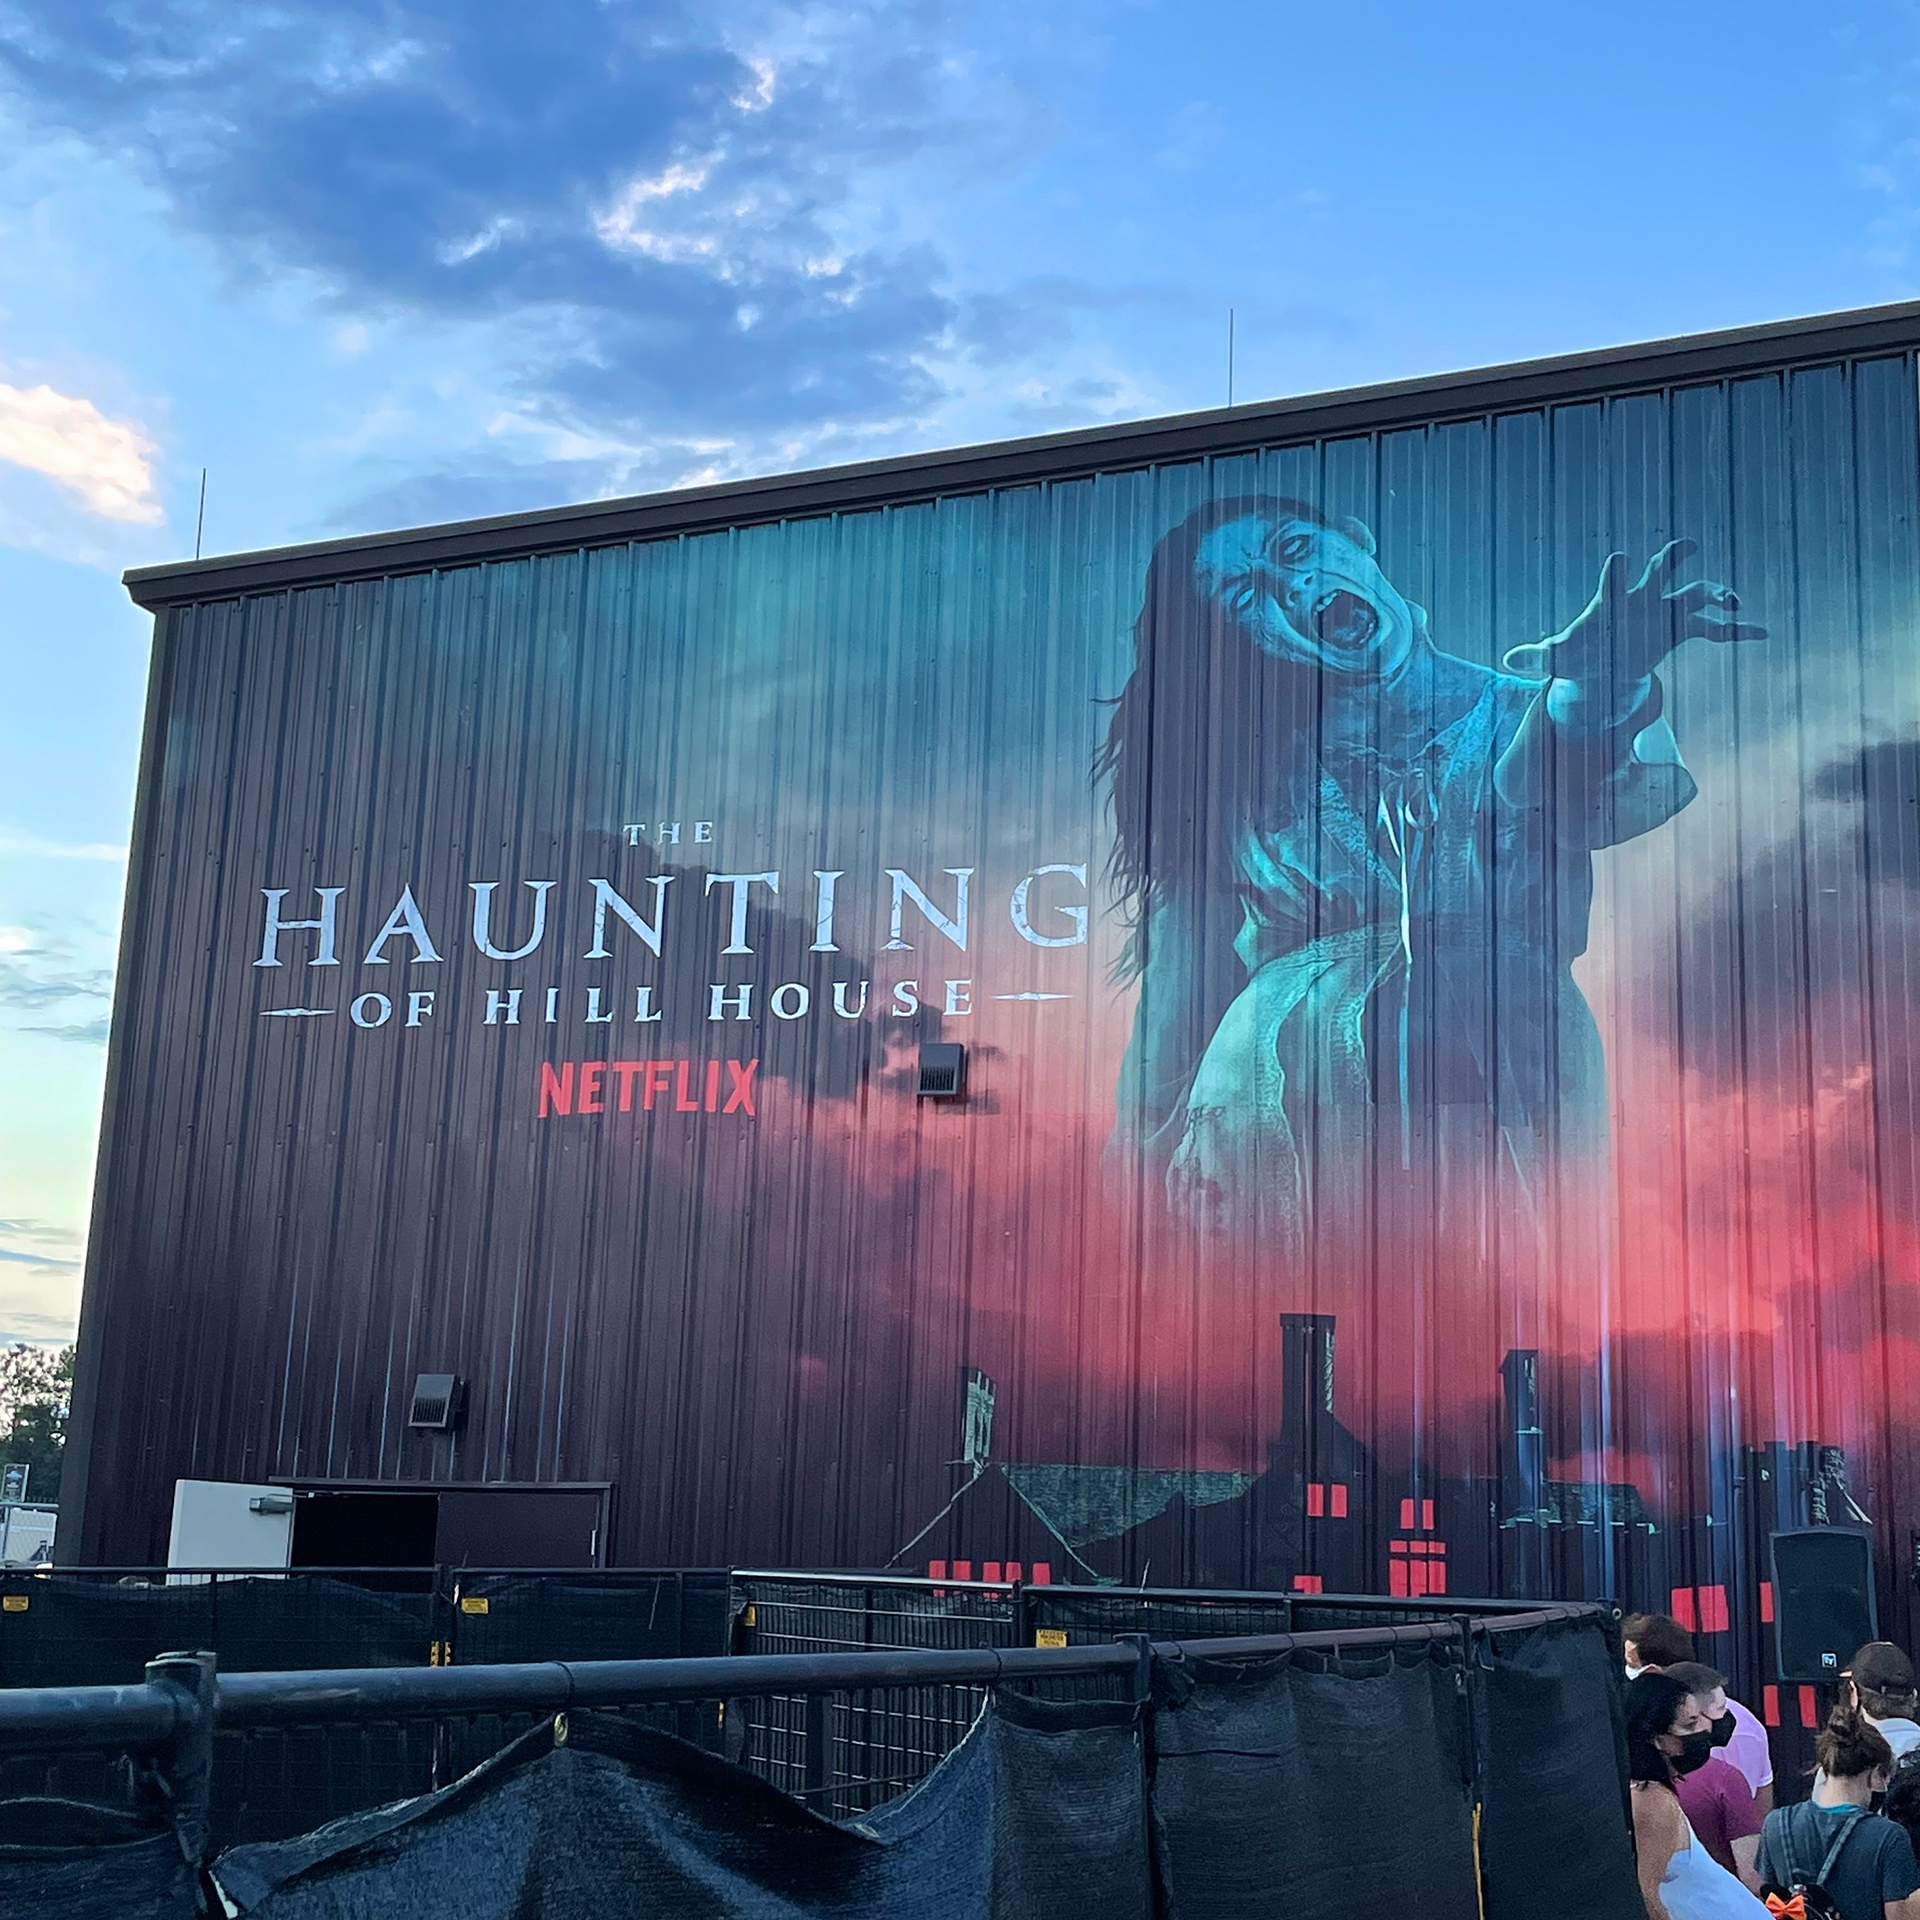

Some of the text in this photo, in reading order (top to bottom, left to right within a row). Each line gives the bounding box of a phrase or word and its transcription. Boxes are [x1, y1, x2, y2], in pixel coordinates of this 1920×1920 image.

[623, 821, 713, 847] THE
[252, 863, 1090, 967] HAUNTING
[350, 979, 973, 1028] OF HILL HOUSE
[538, 1058, 760, 1118] NETFLIX
